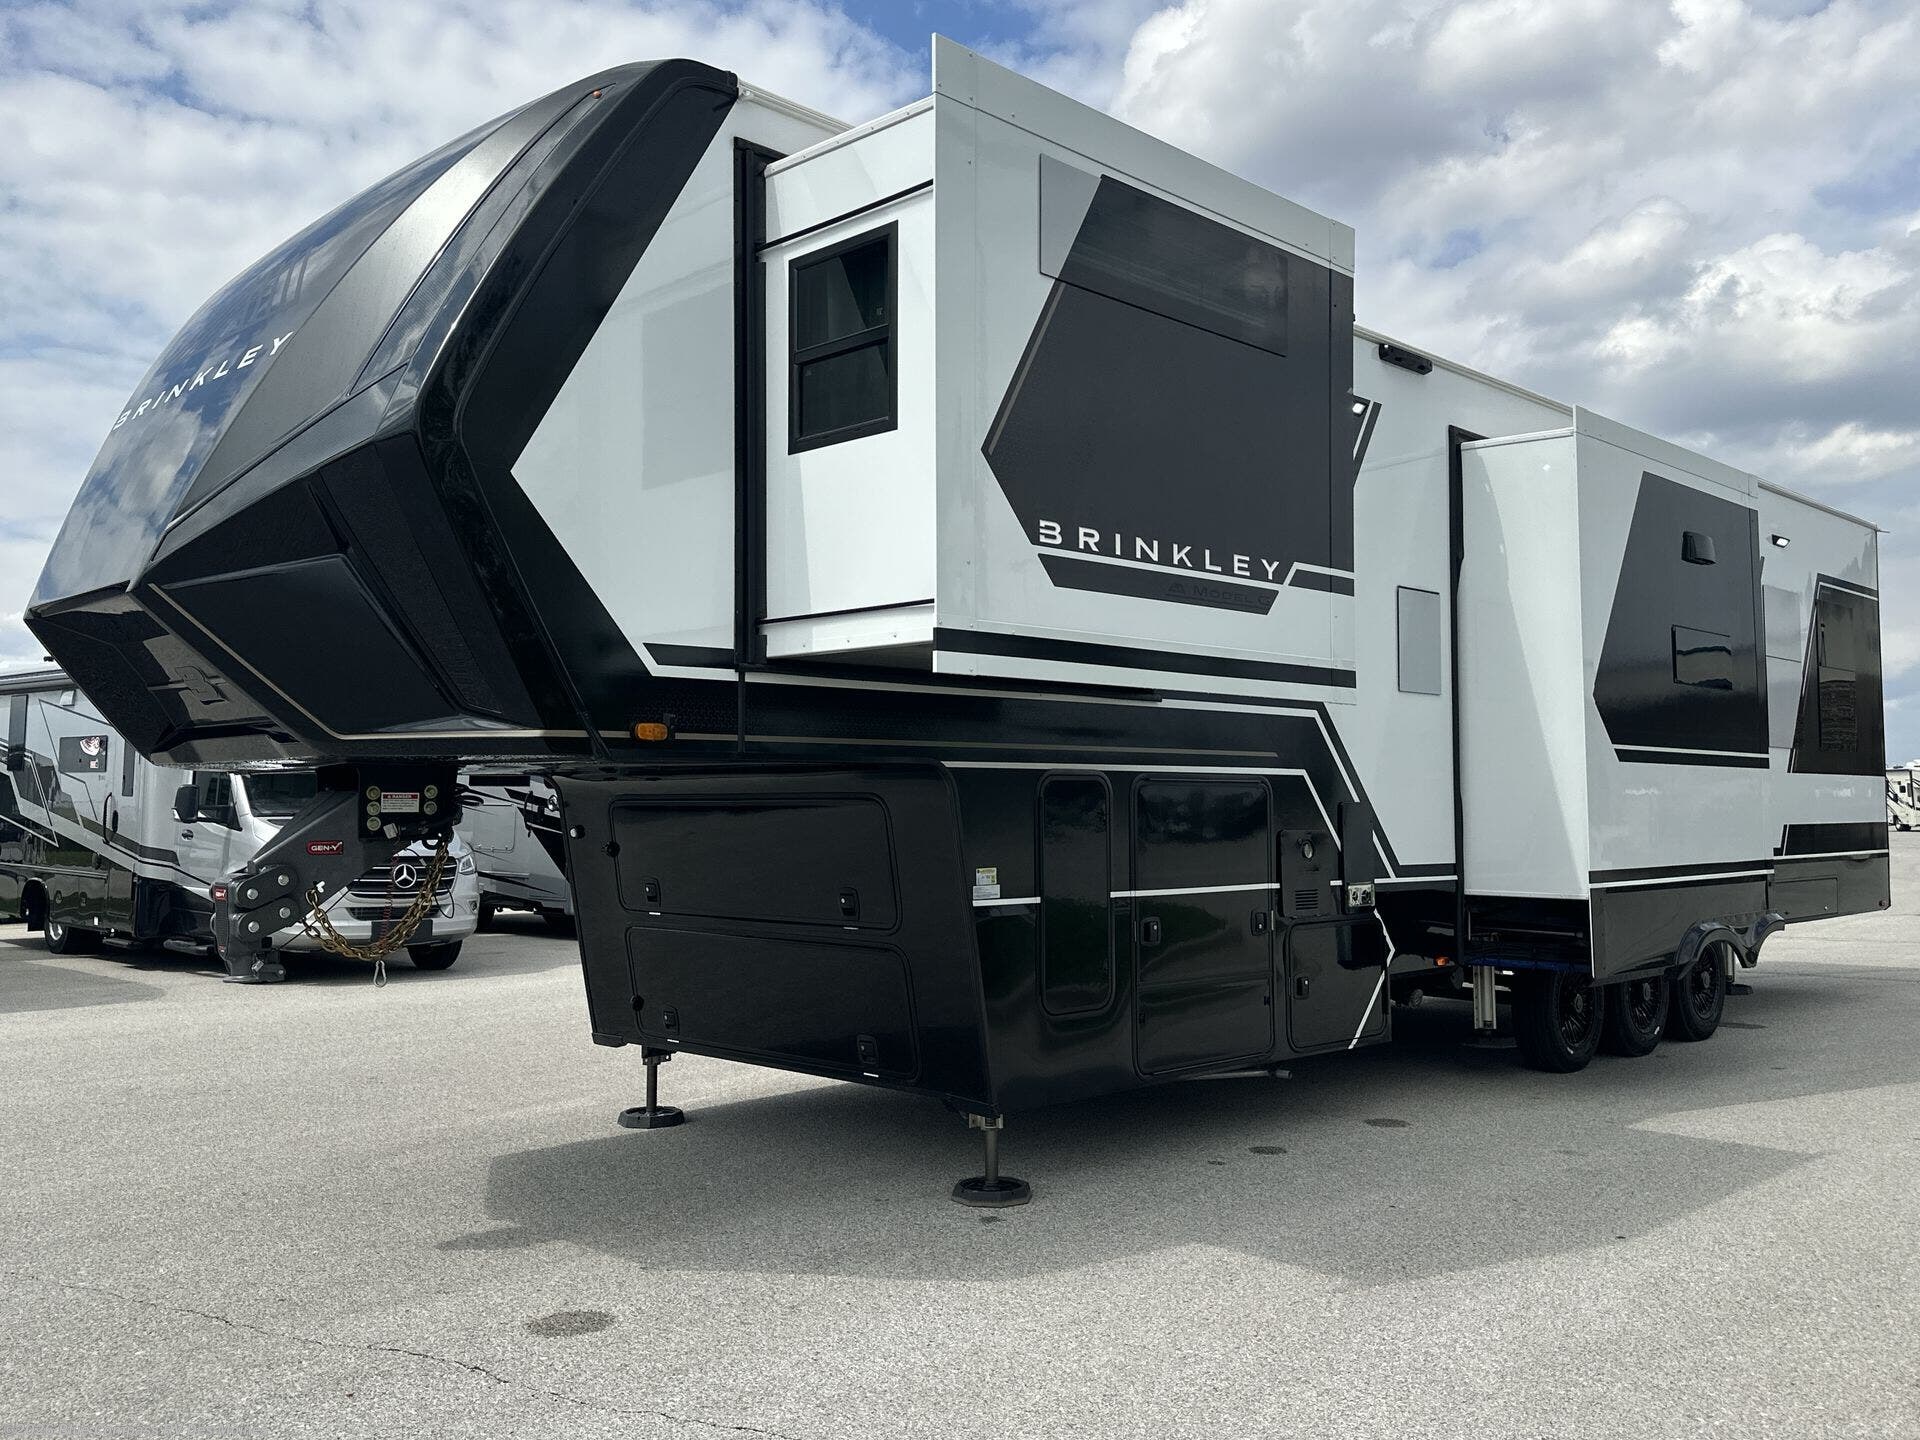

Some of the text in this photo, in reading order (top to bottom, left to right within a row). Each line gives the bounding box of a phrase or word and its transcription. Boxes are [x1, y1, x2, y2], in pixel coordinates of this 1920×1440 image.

[112, 331, 293, 430] BRINKLEY
[1039, 520, 1280, 580] BRINKLEY
[311, 842, 342, 851] GEN-Y
